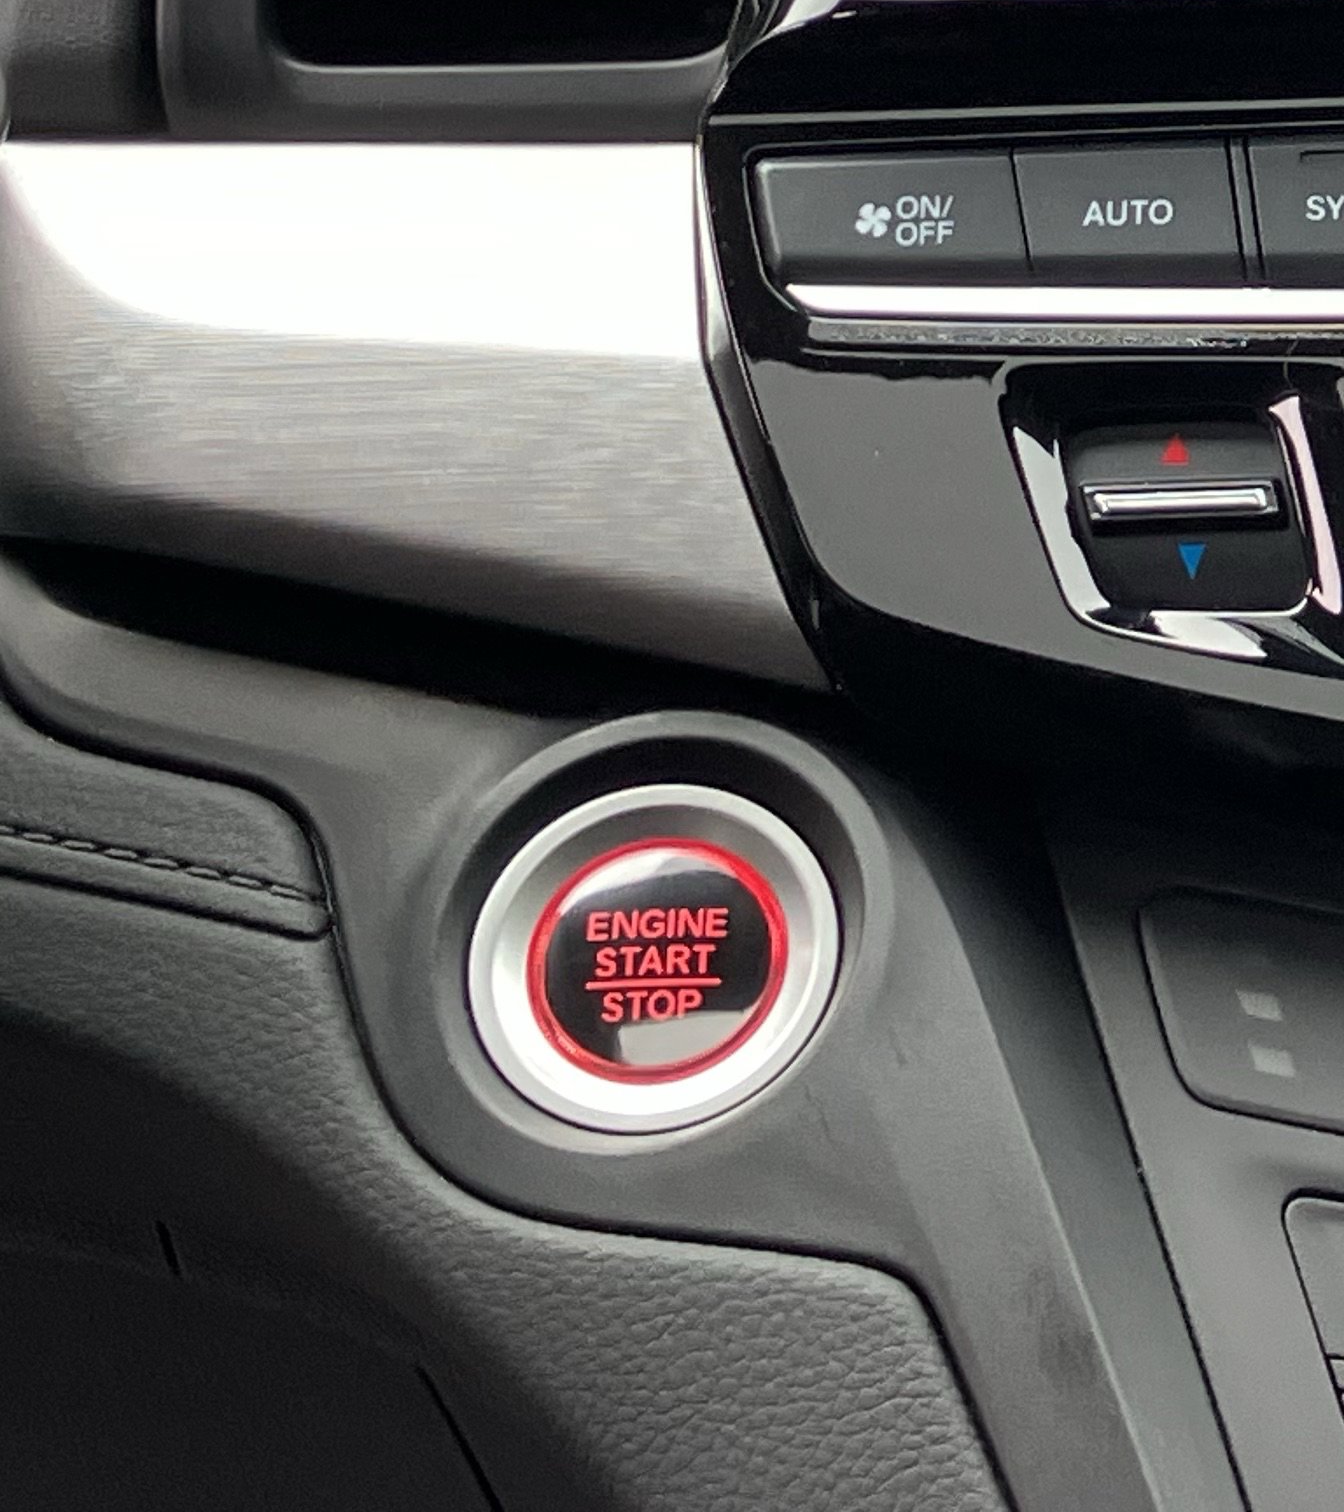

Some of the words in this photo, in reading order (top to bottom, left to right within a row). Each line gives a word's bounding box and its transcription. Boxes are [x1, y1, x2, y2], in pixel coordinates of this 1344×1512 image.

[1082, 198, 1174, 227] AUTO
[895, 220, 955, 247] OFF
[585, 907, 730, 942] ENGINE
[594, 943, 717, 978] START
[601, 988, 704, 1023] STOP
